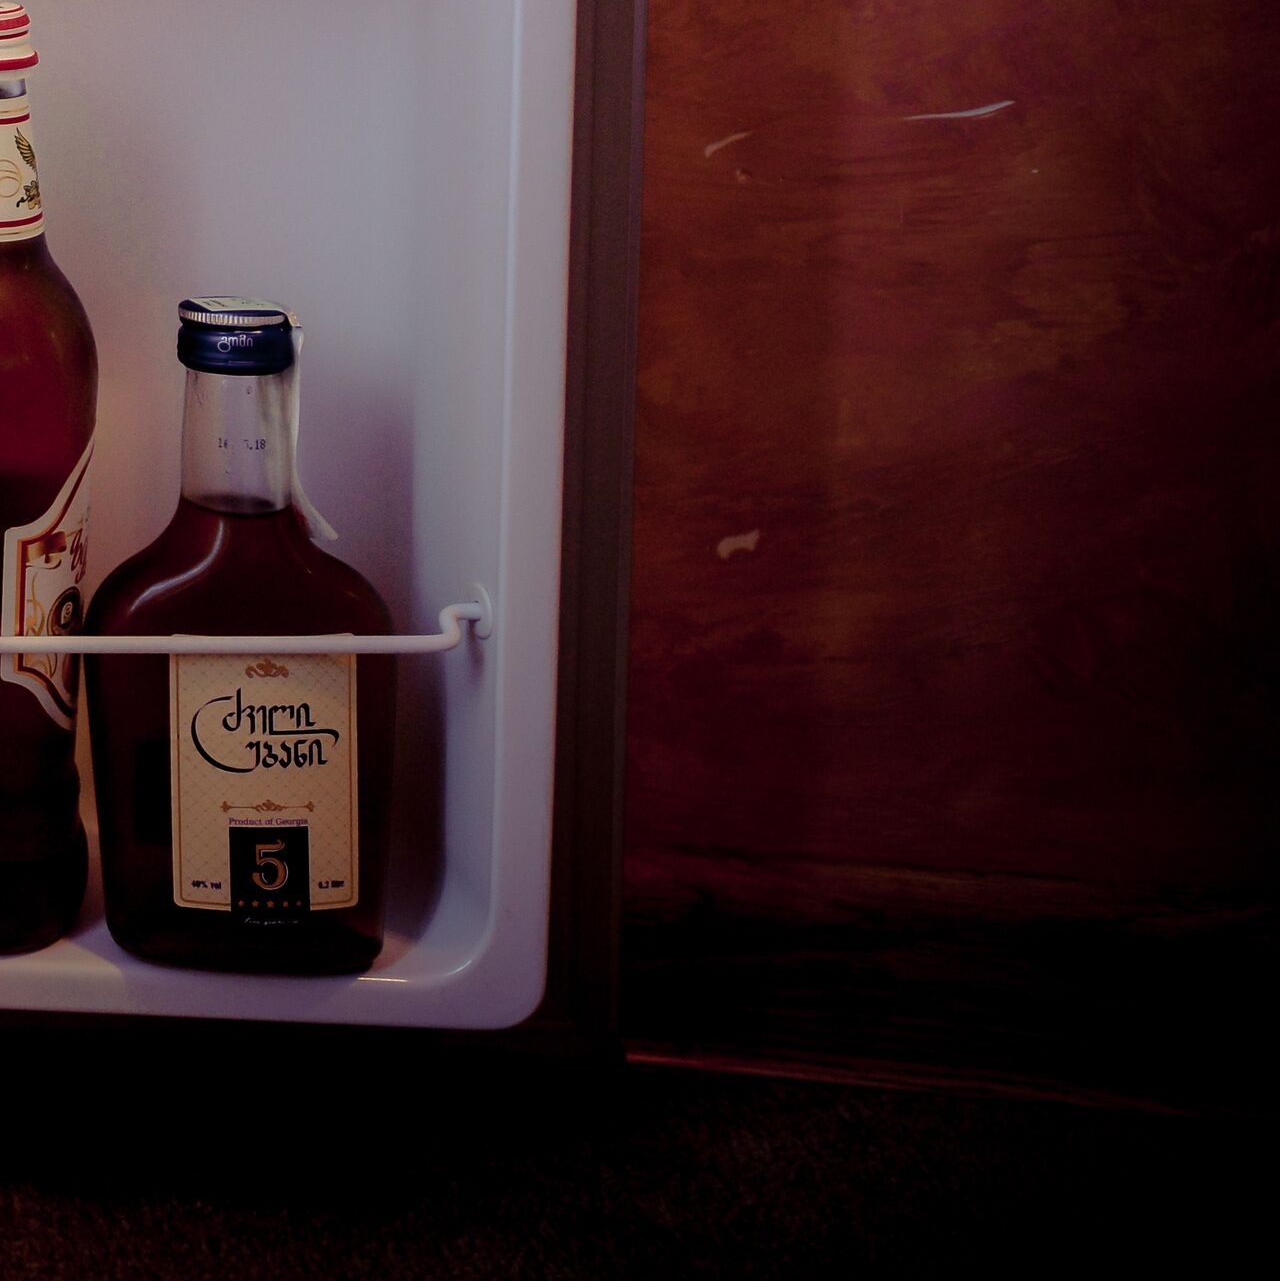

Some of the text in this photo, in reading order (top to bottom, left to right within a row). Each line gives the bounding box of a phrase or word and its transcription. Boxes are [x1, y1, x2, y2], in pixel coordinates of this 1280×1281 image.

[229, 817, 309, 827] Product of Georgia
[249, 838, 290, 892] 5
